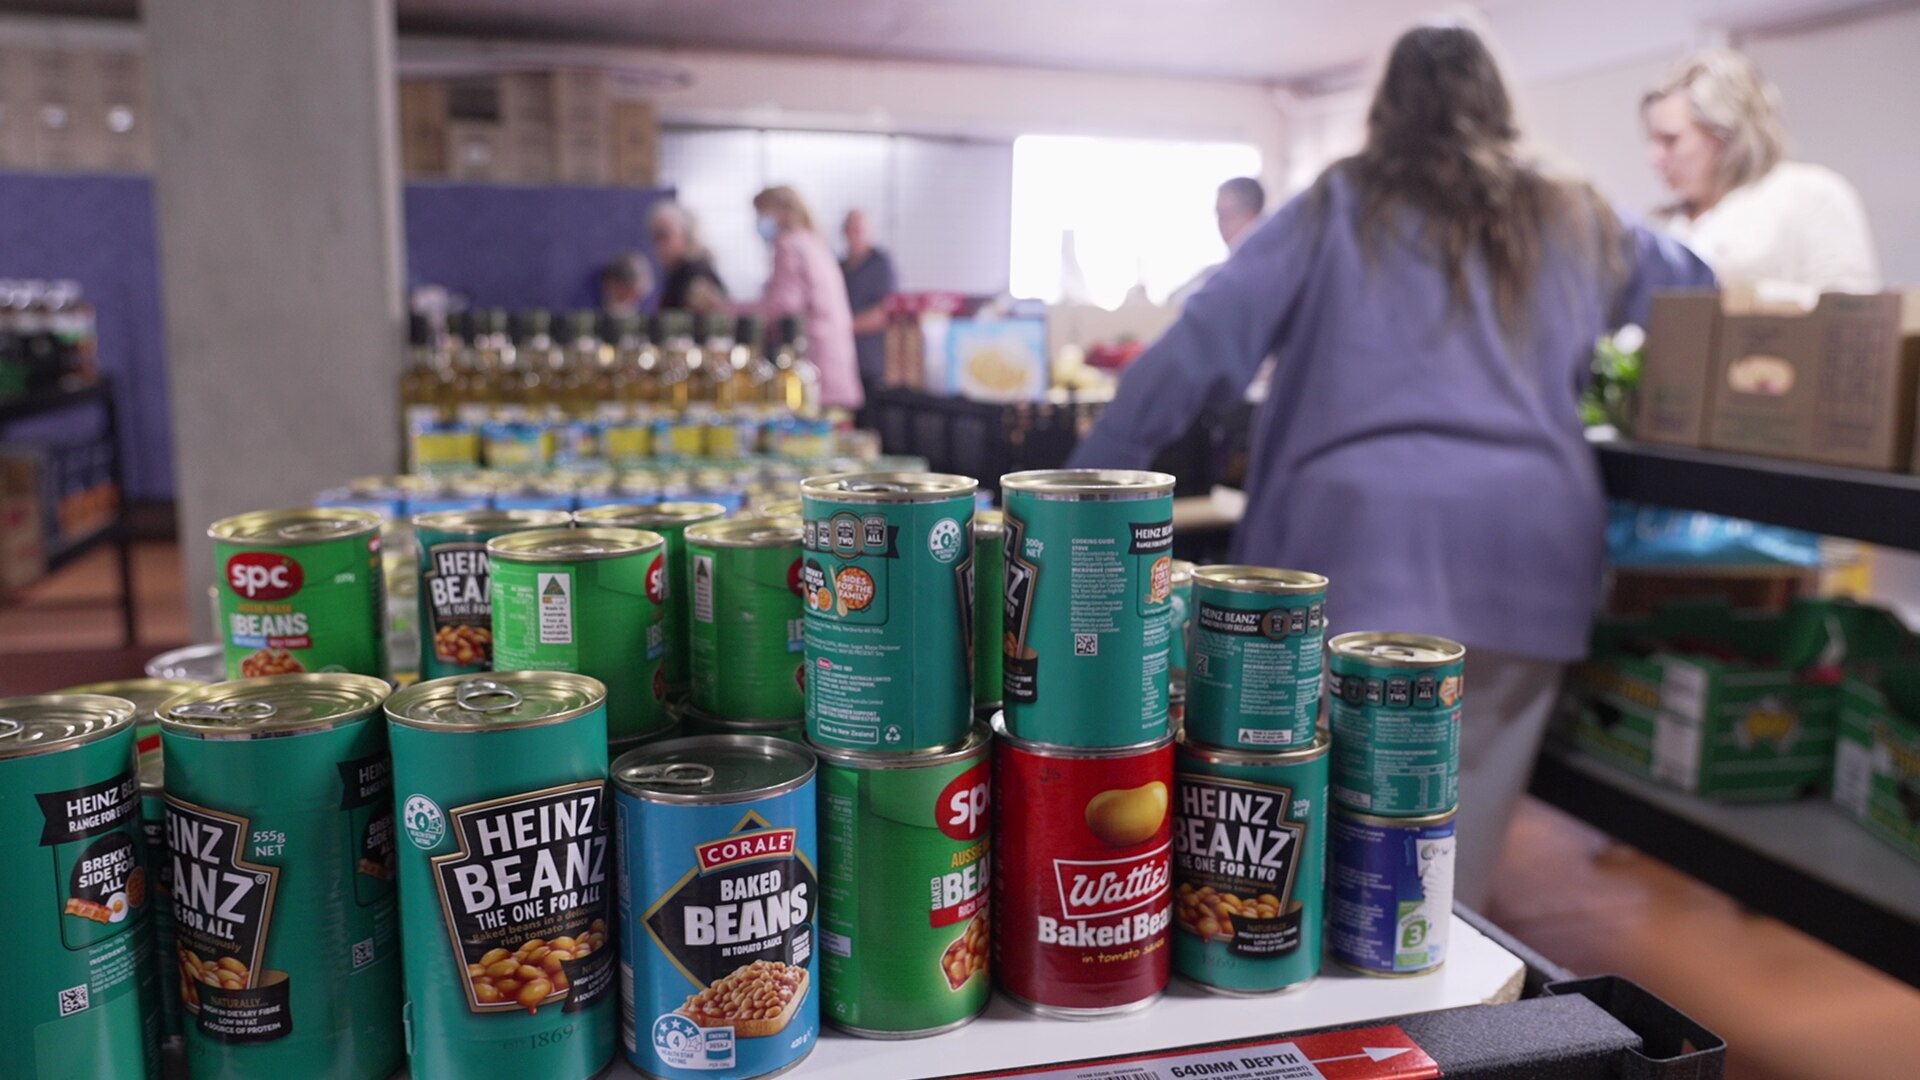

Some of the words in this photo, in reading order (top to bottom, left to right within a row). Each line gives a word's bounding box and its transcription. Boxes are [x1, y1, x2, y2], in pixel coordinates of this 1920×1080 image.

[839, 537, 854, 545] TWO
[867, 534, 881, 542] ALL
[943, 535, 949, 546] 4
[1135, 528, 1161, 540] HEINZ
[1025, 538, 1044, 552] 300g
[1026, 548, 1041, 558] NET
[232, 563, 289, 597] spc
[837, 581, 854, 590] FOR
[856, 585, 873, 594] THE
[842, 575, 866, 584] SIDES
[839, 590, 870, 601] FAMILY
[235, 613, 309, 637] BEANS
[1201, 607, 1223, 620] HEINZ
[1225, 610, 1256, 624] BEANZ
[1233, 623, 1258, 632] OCCASION
[850, 730, 875, 738] Zealand
[66, 787, 120, 818] HEINZ
[1181, 785, 1273, 826] HEINZ
[1293, 799, 1310, 810] 300g
[68, 816, 101, 833] RANGE
[100, 808, 116, 825] FOR
[418, 815, 425, 828] 4
[1294, 807, 1309, 818] NET
[475, 795, 597, 857] HEINZ
[253, 830, 286, 844] 555g
[1174, 816, 1291, 869] BEANZ
[255, 844, 285, 857] NET
[706, 835, 789, 864] CORALE
[82, 844, 133, 875] BREKKY
[1194, 856, 1217, 873] ONE
[1220, 861, 1246, 878] FOR
[1248, 866, 1277, 881] TWO
[78, 867, 113, 888] SIDE
[114, 857, 136, 877] FOR
[453, 835, 607, 914] BEANZ
[100, 877, 124, 896] ALL
[720, 869, 782, 902] BAKED
[930, 876, 942, 911] BAKED
[475, 909, 507, 931] THE
[512, 900, 545, 923] ONE
[549, 891, 579, 914] FOR
[581, 885, 601, 906] ALL
[683, 882, 809, 946] BEANS
[958, 900, 976, 919] RICH
[182, 908, 204, 931] FOR
[206, 917, 235, 940] ALL
[472, 927, 507, 942] Baked
[508, 920, 542, 934] beans
[543, 916, 554, 926] in
[1038, 915, 1131, 947] Baked
[500, 934, 521, 946] rich
[525, 925, 564, 940] tomato
[1409, 924, 1422, 945] 3
[722, 947, 732, 957] IN
[732, 940, 762, 956] TOMATO
[763, 935, 783, 949] SAUCE
[1082, 953, 1094, 963] in
[1098, 948, 1140, 963] tomato
[227, 1009, 257, 1018] DIETARY
[258, 1004, 280, 1016] FIBRE
[208, 1022, 235, 1034] SOURCE
[235, 1027, 245, 1035] OF
[247, 1022, 281, 1034] PROTEIN
[218, 1017, 234, 1025] LOW
[236, 1018, 243, 1026] IN
[244, 1018, 258, 1026] FAT
[529, 1023, 575, 1050] 1869
[672, 1034, 680, 1048] 4
[661, 1048, 680, 1057] HEALTH
[680, 1051, 694, 1059] STAR
[667, 1057, 688, 1065] RATING
[1171, 1060, 1239, 1078] 640MM
[1240, 1053, 1300, 1070] DEPTH
[1283, 1071, 1314, 1079] SHELVES
[1223, 1072, 1253, 1080] OUTSIDE
